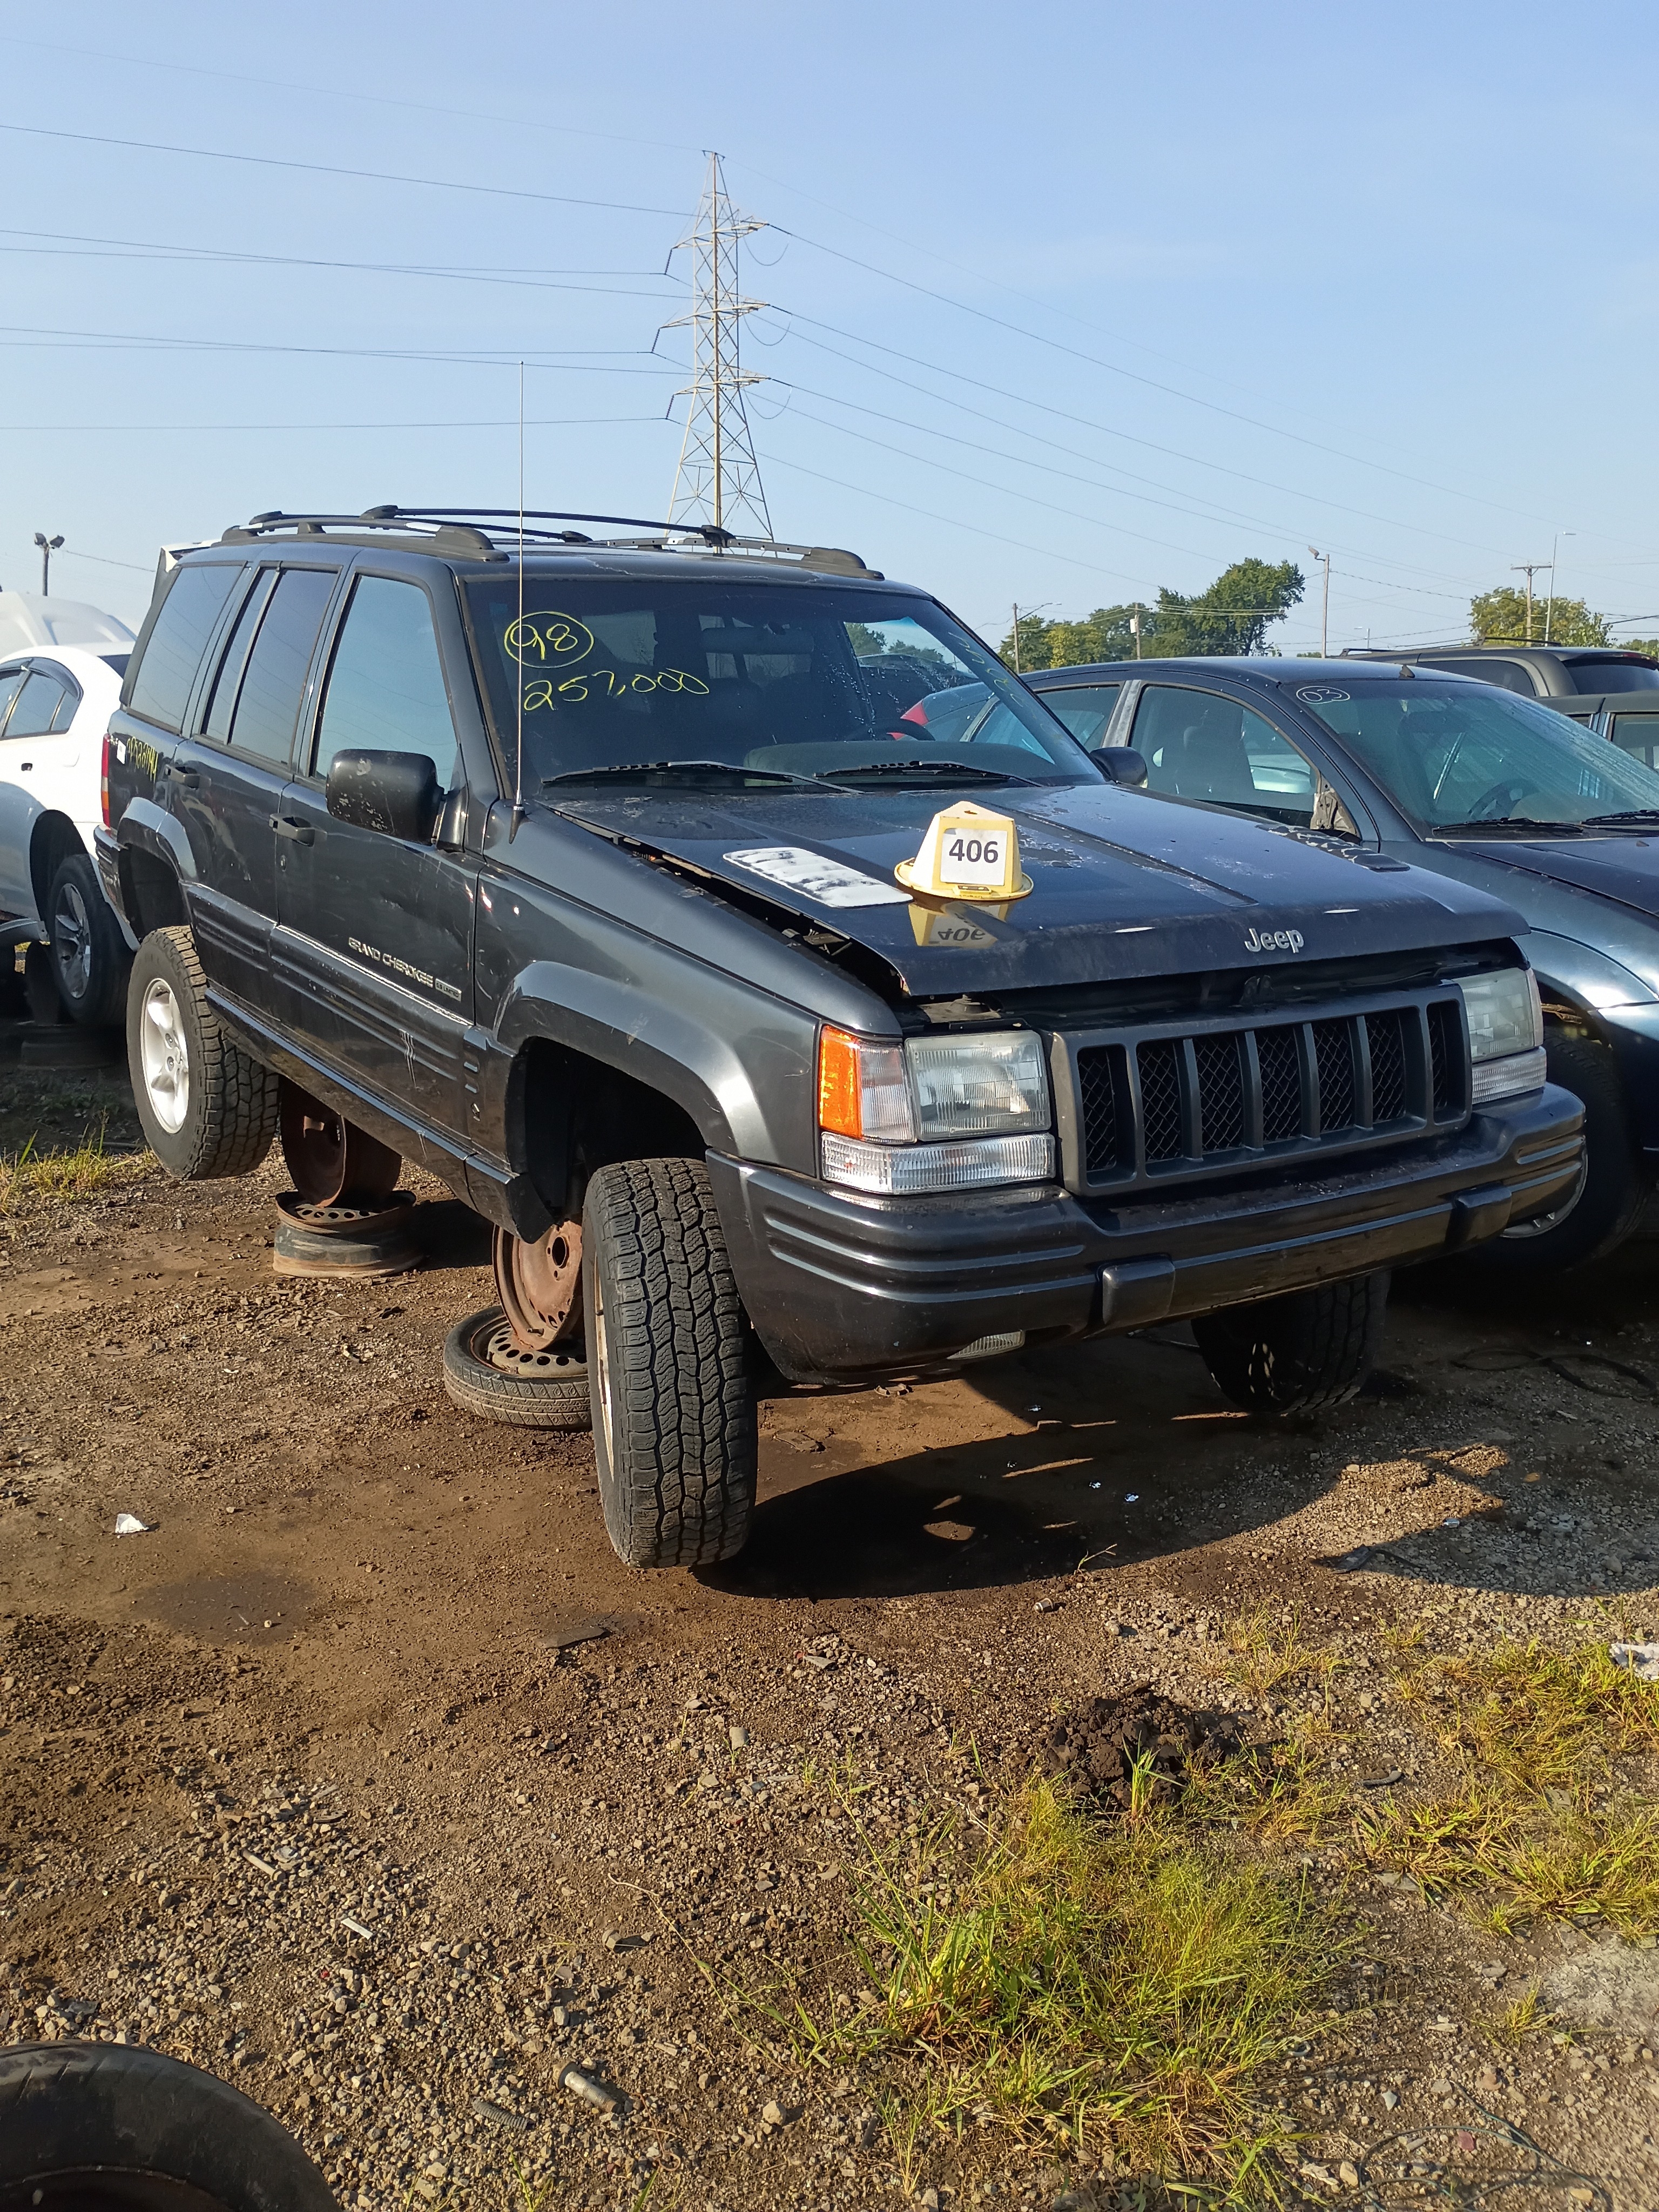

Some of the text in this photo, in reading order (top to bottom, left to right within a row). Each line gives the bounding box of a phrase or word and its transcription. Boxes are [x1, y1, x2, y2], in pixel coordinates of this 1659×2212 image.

[510, 623, 578, 660] 98
[524, 669, 710, 711] 257,000
[1302, 689, 1342, 702] 03
[949, 839, 999, 864] 406
[1244, 928, 1304, 954] Jeep
[348, 936, 381, 961] GRAND
[382, 953, 434, 988] CHEROKEE
[443, 985, 459, 998] LIMITED
